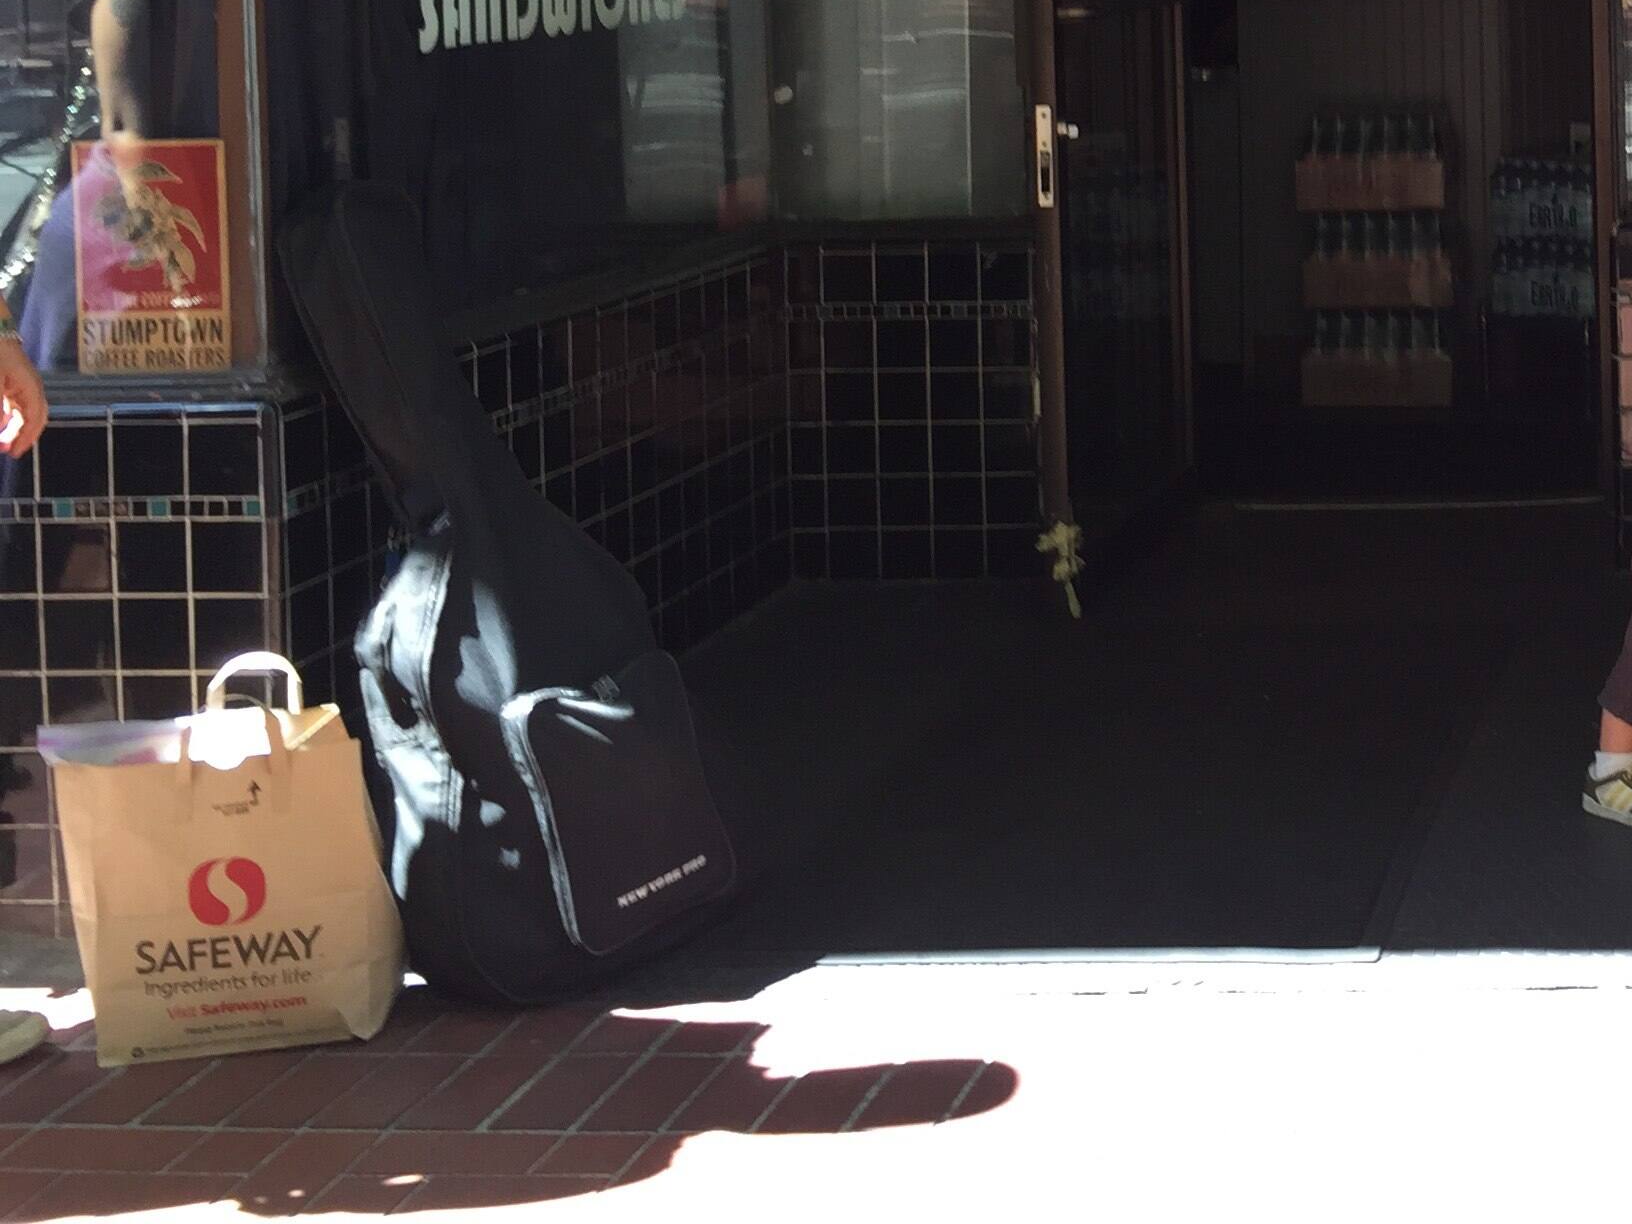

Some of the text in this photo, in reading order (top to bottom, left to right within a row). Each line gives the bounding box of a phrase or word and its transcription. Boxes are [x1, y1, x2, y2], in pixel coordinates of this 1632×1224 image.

[83, 317, 224, 345] STUMPTOWN
[616, 883, 649, 908] NEW
[136, 924, 324, 975] SAFEWAY
[144, 976, 248, 999] Ingredients
[252, 972, 280, 989] for
